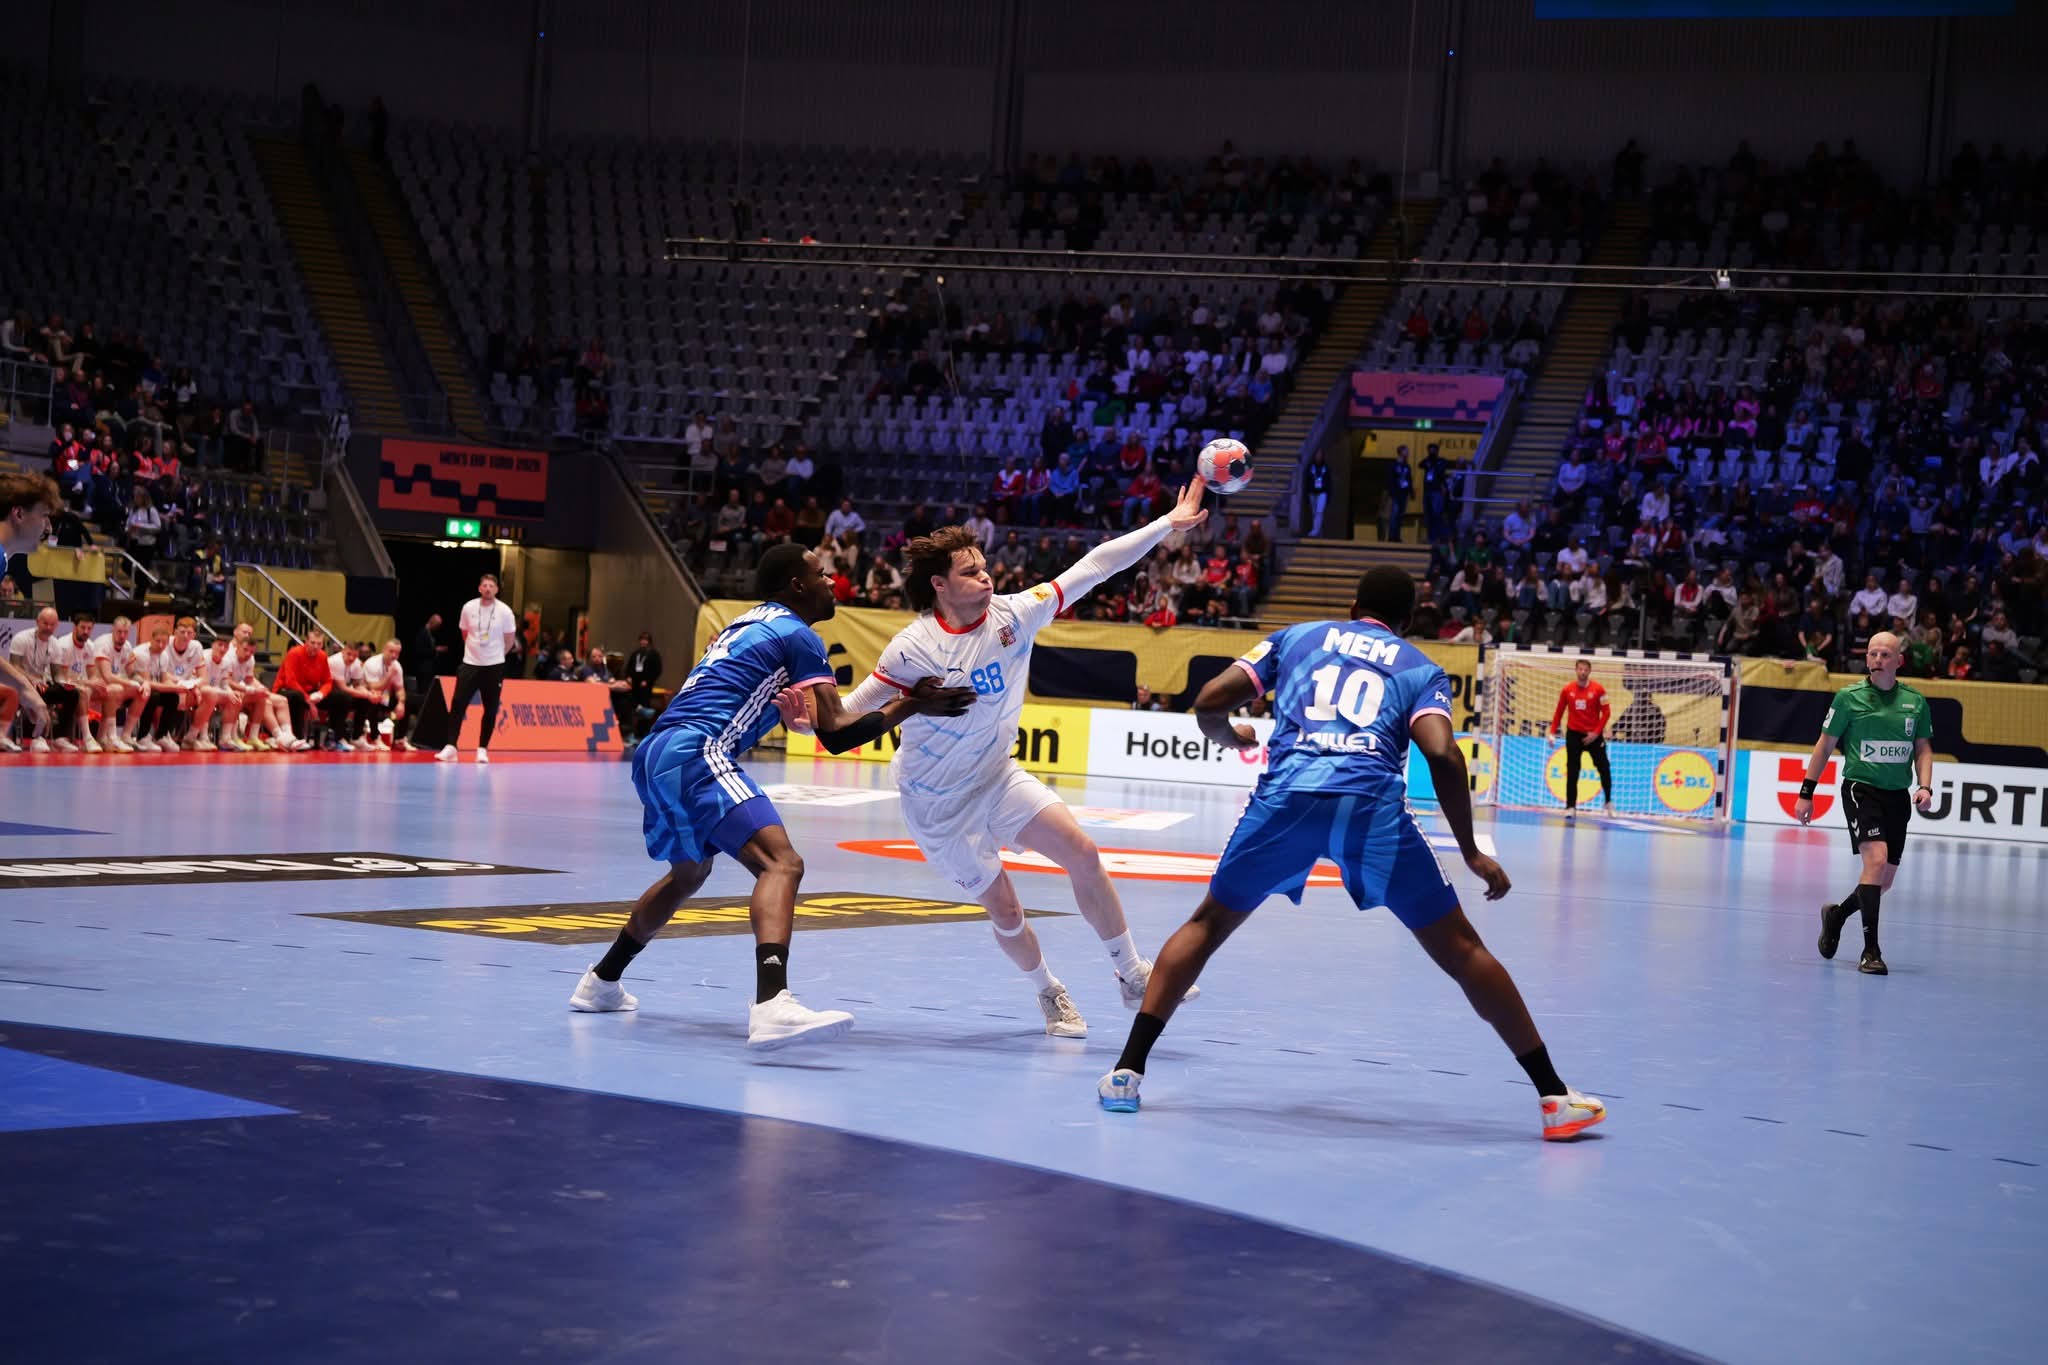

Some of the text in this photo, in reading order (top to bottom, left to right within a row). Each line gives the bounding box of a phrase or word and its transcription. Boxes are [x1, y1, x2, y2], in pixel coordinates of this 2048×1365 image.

[277, 597, 318, 637] PURE
[1322, 627, 1400, 666] MEM
[970, 661, 1005, 695] 88
[1304, 664, 1385, 728] 10
[512, 703, 585, 727] PURE GREATNESS
